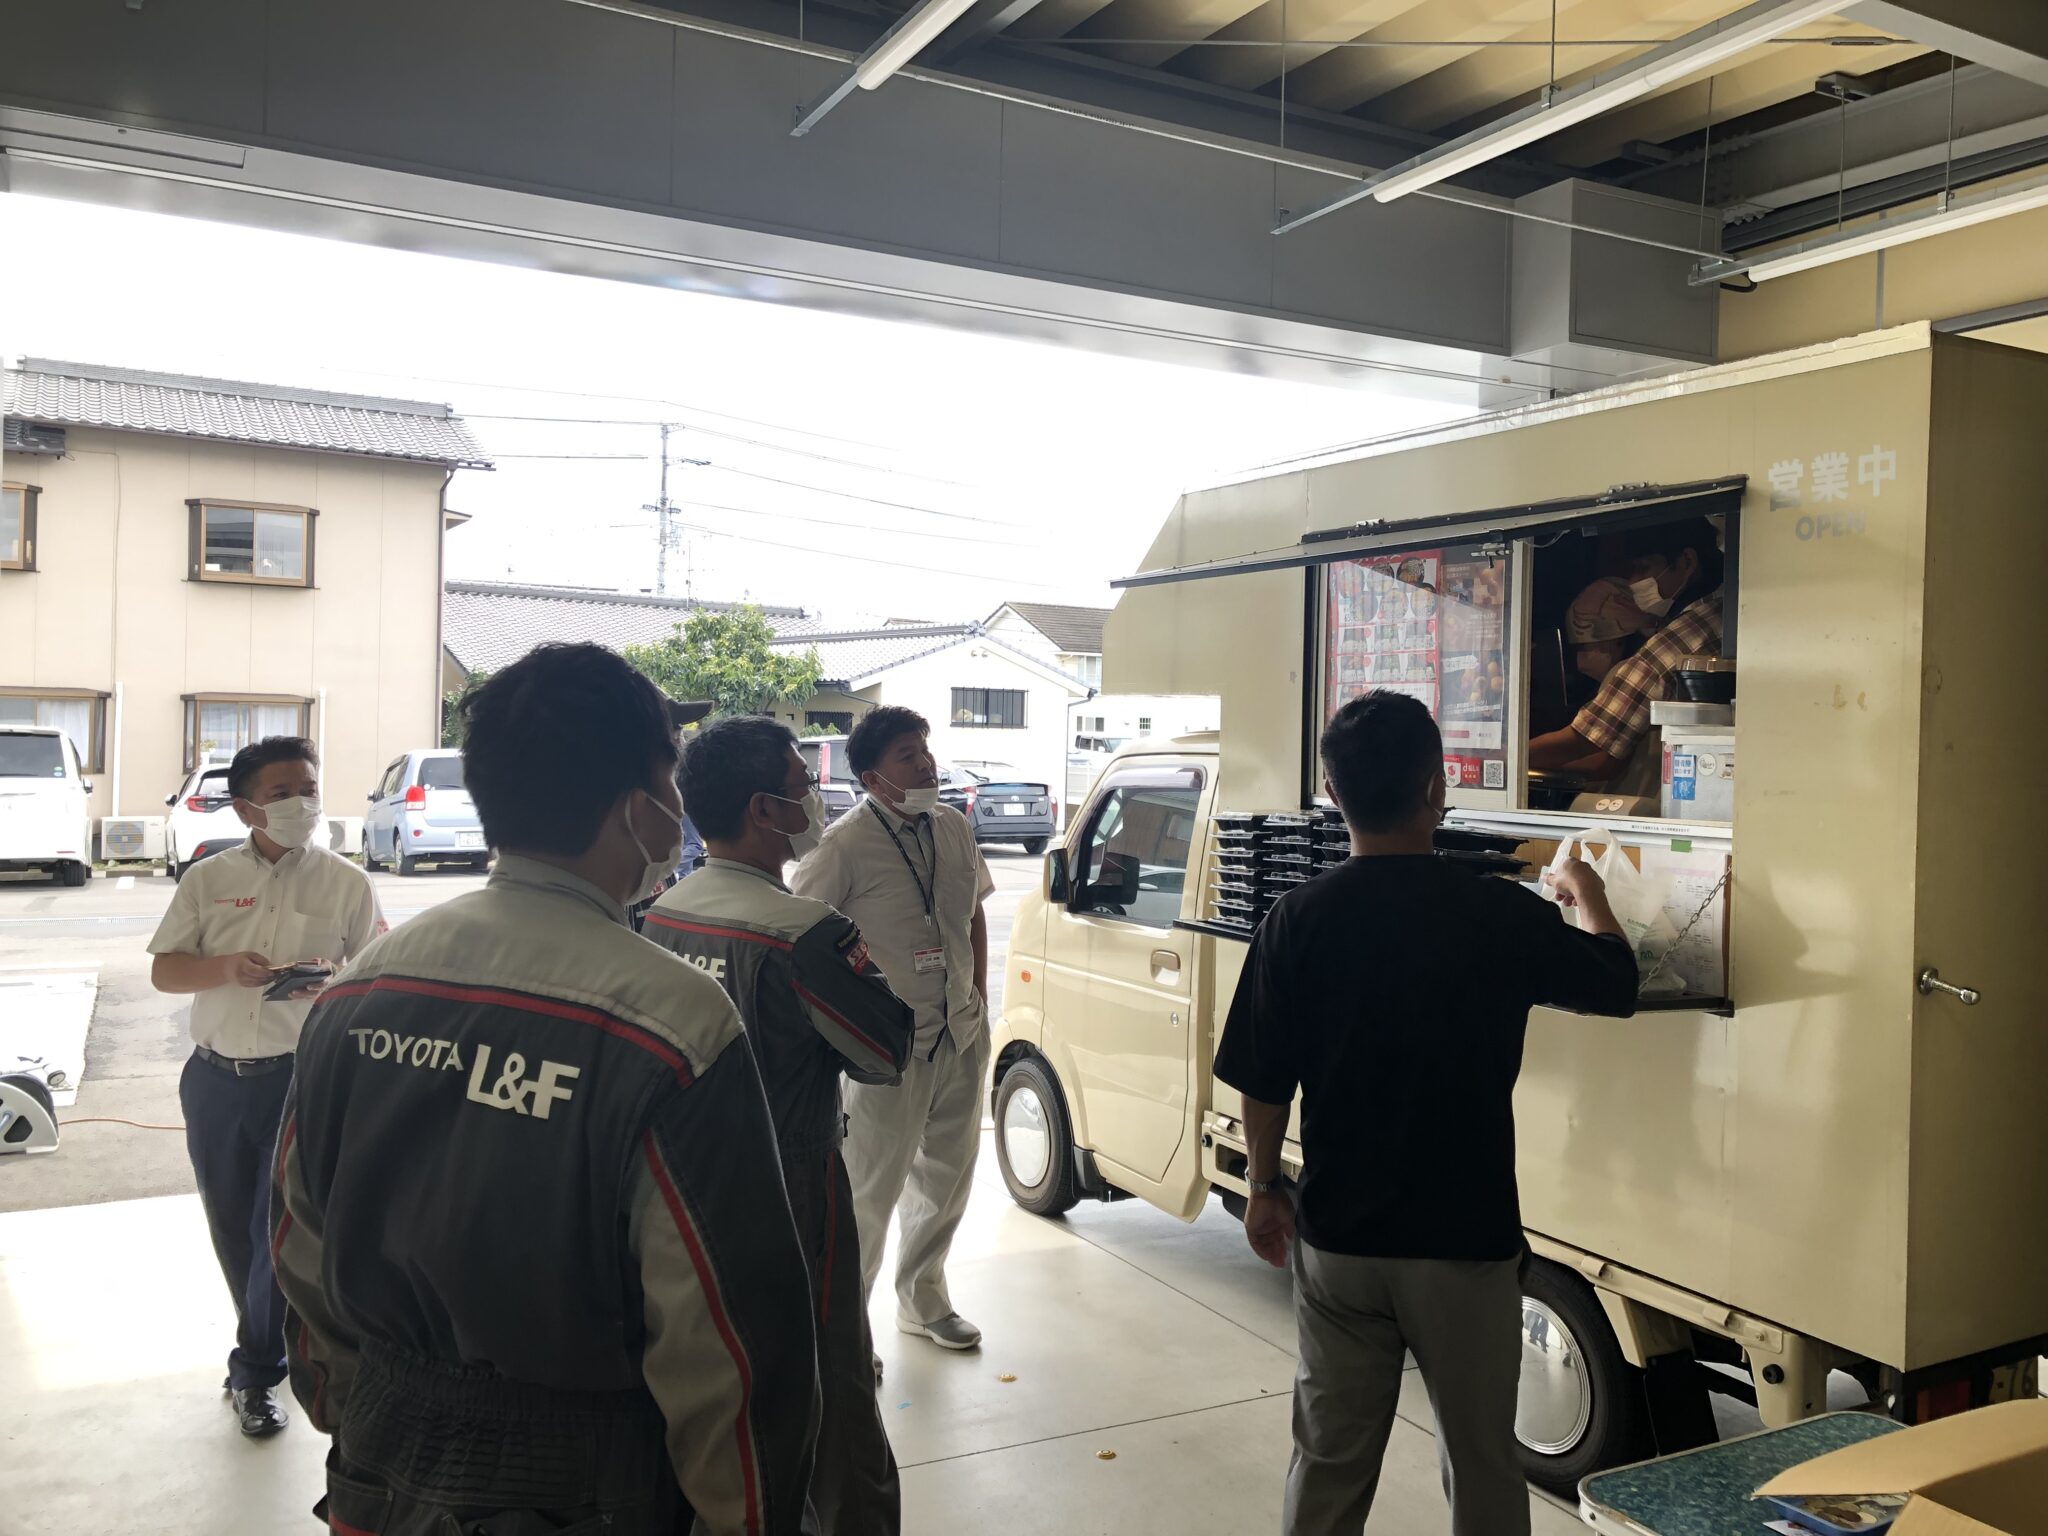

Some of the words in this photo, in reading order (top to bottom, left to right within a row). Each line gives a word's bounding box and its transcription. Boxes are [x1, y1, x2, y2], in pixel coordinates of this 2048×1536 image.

[1768, 444, 1897, 512] 営業中
[1795, 512, 1866, 541] OPEN
[348, 1028, 464, 1071] TOYOTA
[466, 1043, 581, 1120] L&F
